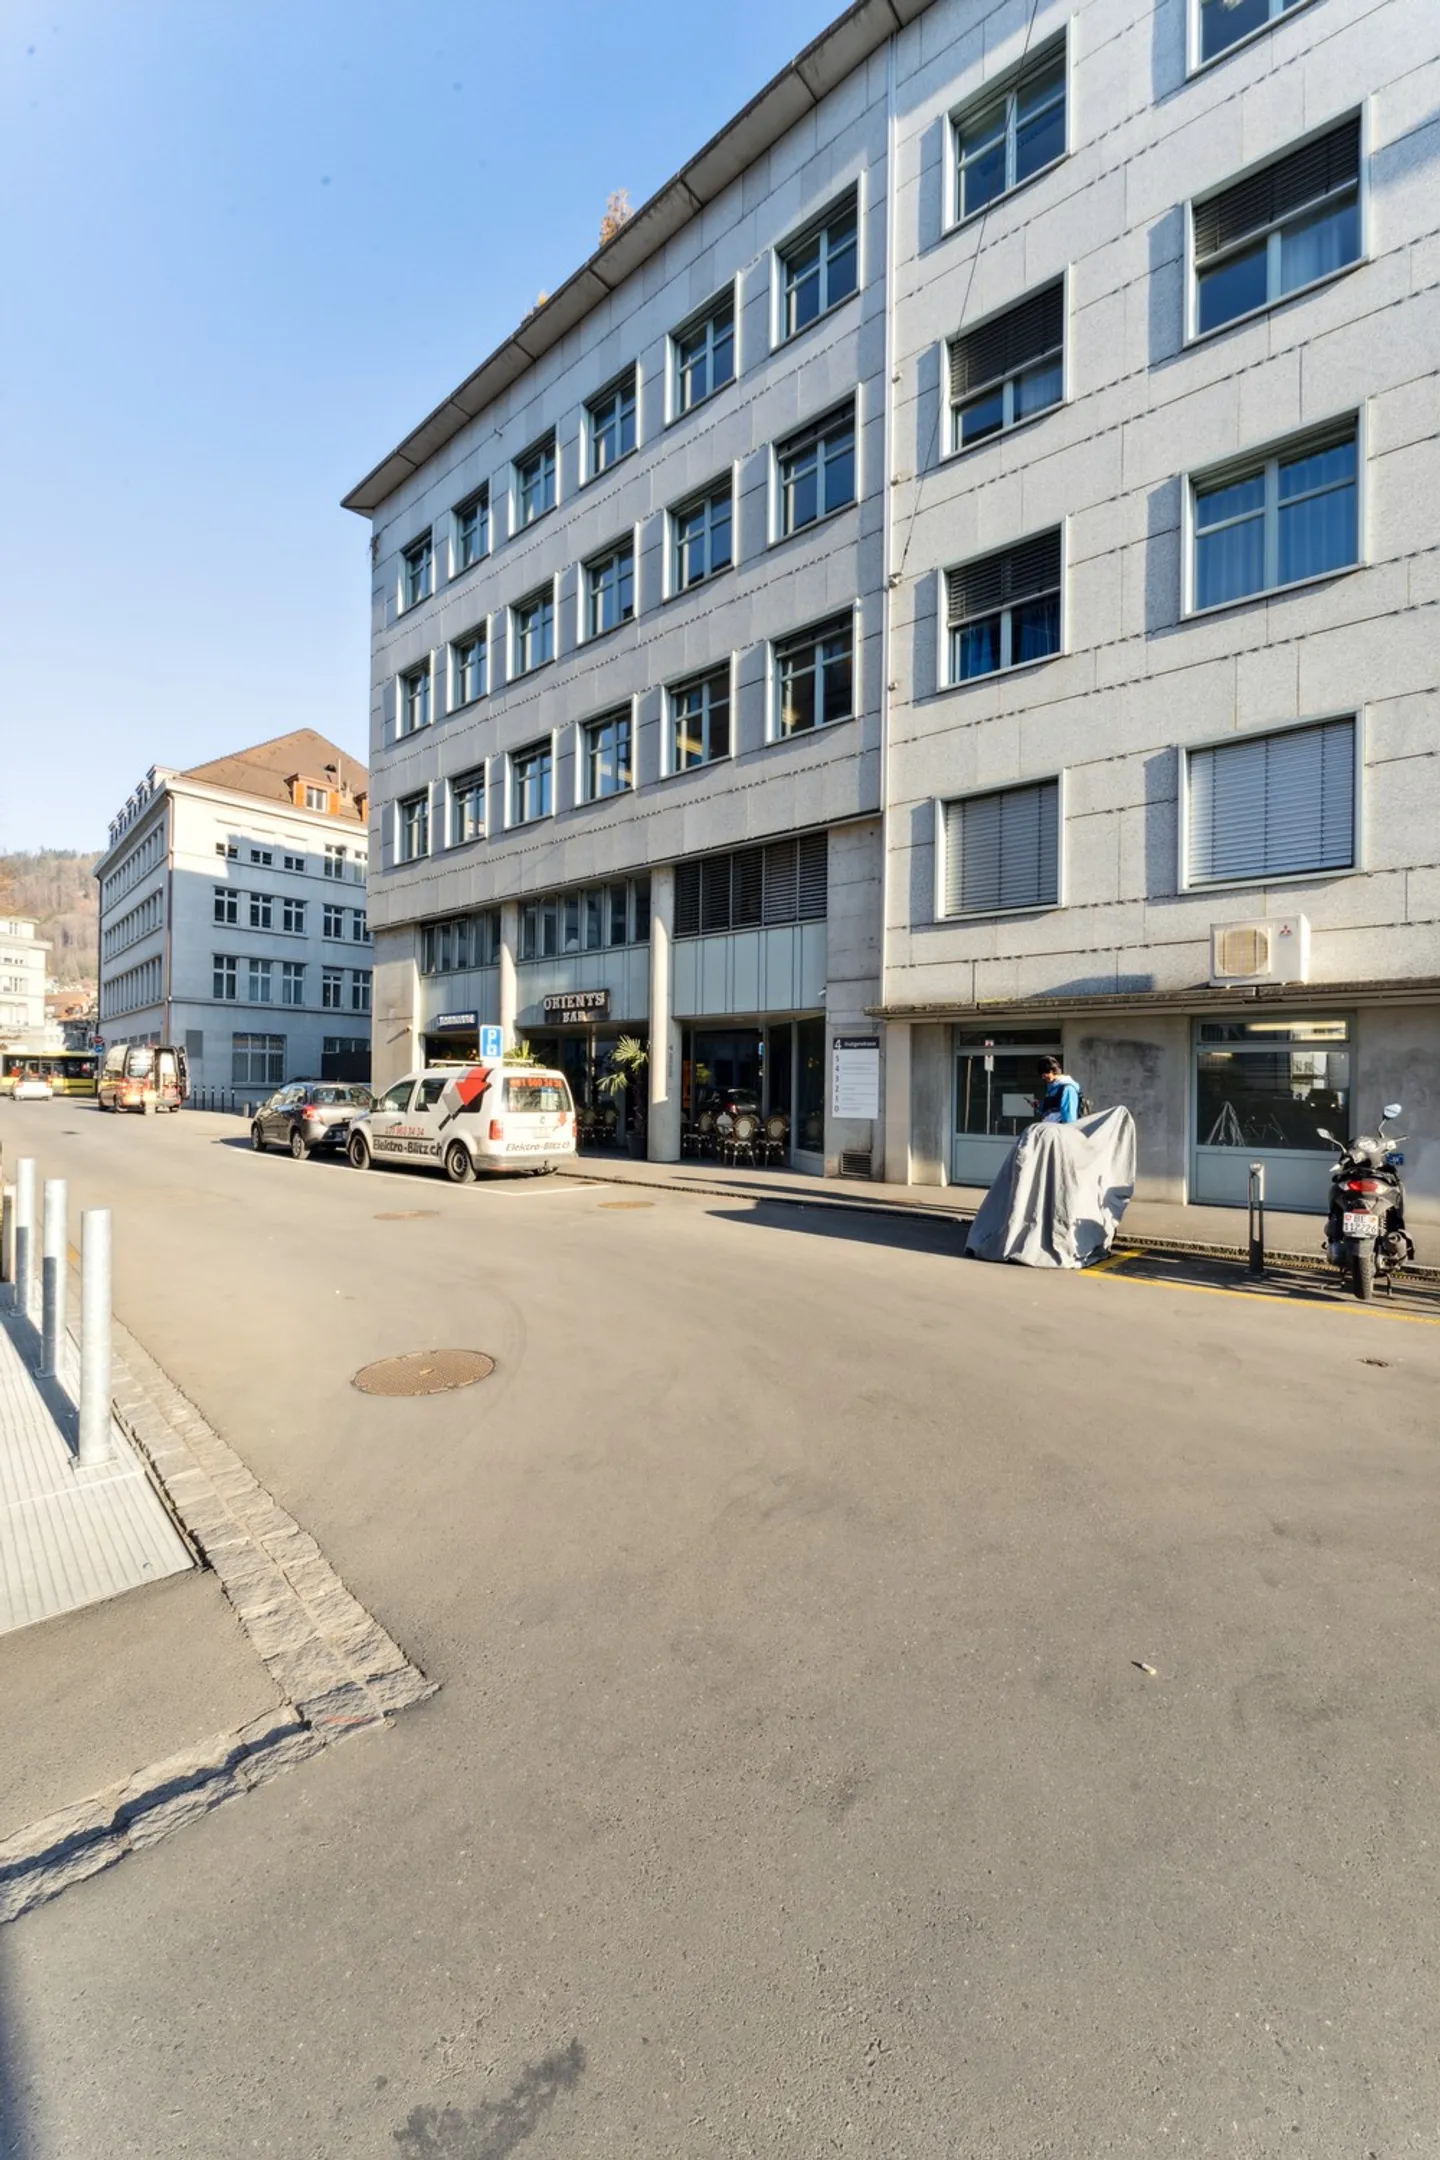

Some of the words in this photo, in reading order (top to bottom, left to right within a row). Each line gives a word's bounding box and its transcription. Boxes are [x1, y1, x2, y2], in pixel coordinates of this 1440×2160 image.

[543, 991, 605, 1011] ORIENTS
[562, 1010, 587, 1023] BAR
[487, 1029, 497, 1042] P
